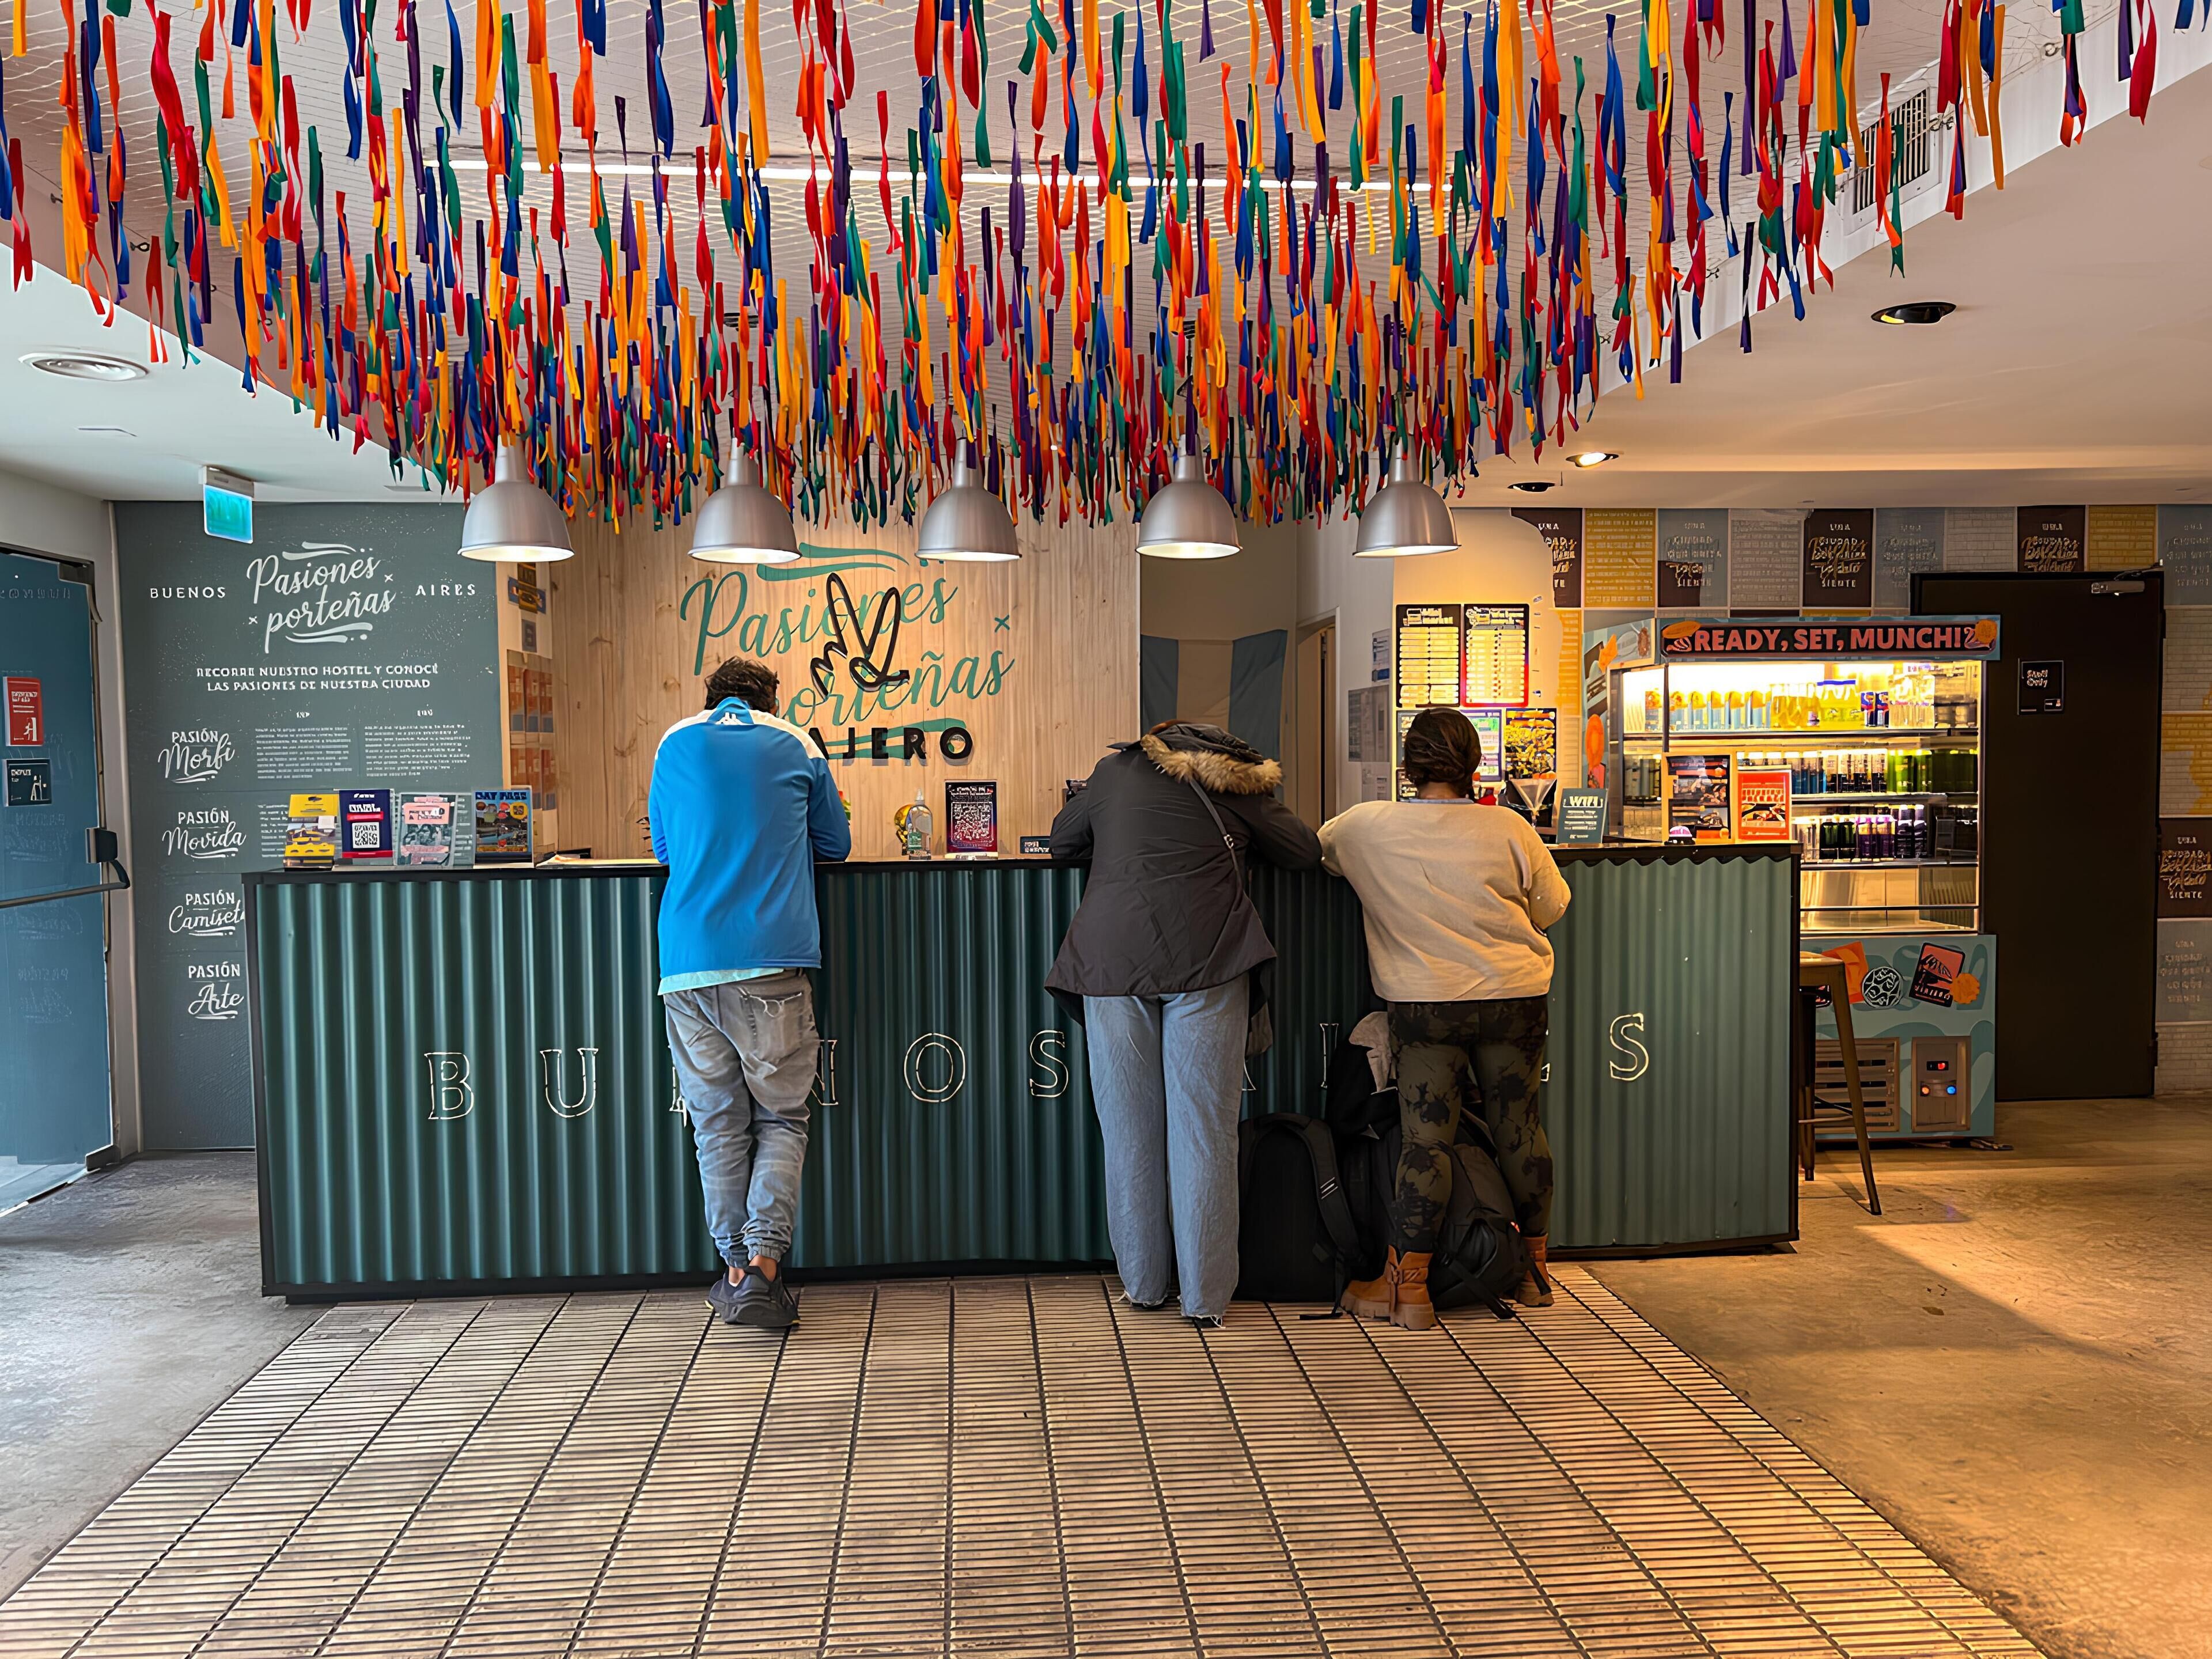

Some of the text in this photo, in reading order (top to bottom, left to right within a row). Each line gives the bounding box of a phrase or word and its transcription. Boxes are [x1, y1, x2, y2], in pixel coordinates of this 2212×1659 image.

[247, 555, 382, 604] Pasiones
[415, 584, 476, 596] AIRES
[150, 586, 226, 599] BUENOS
[264, 584, 397, 654] porteñas
[680, 570, 958, 676] Pasiones
[1694, 627, 1961, 652] READY, SET, MUNCH!
[196, 668, 255, 677] RECORRE
[259, 666, 318, 676] NUESTRO
[323, 666, 372, 676] HOSTEL
[374, 665, 382, 675] Y
[207, 679, 430, 691] LAS PASIONES DE NUESTRA CIUDAD
[775, 650, 1016, 727] orteñas
[172, 728, 218, 743] PASIÓN
[808, 727, 973, 760] AJERO
[157, 733, 235, 779] Morfi
[178, 808, 229, 824] PASIÓN
[162, 821, 247, 856] Movida
[185, 889, 235, 906] PASIÓN
[188, 961, 240, 978] PASIÓN
[188, 983, 244, 1015] Arte
